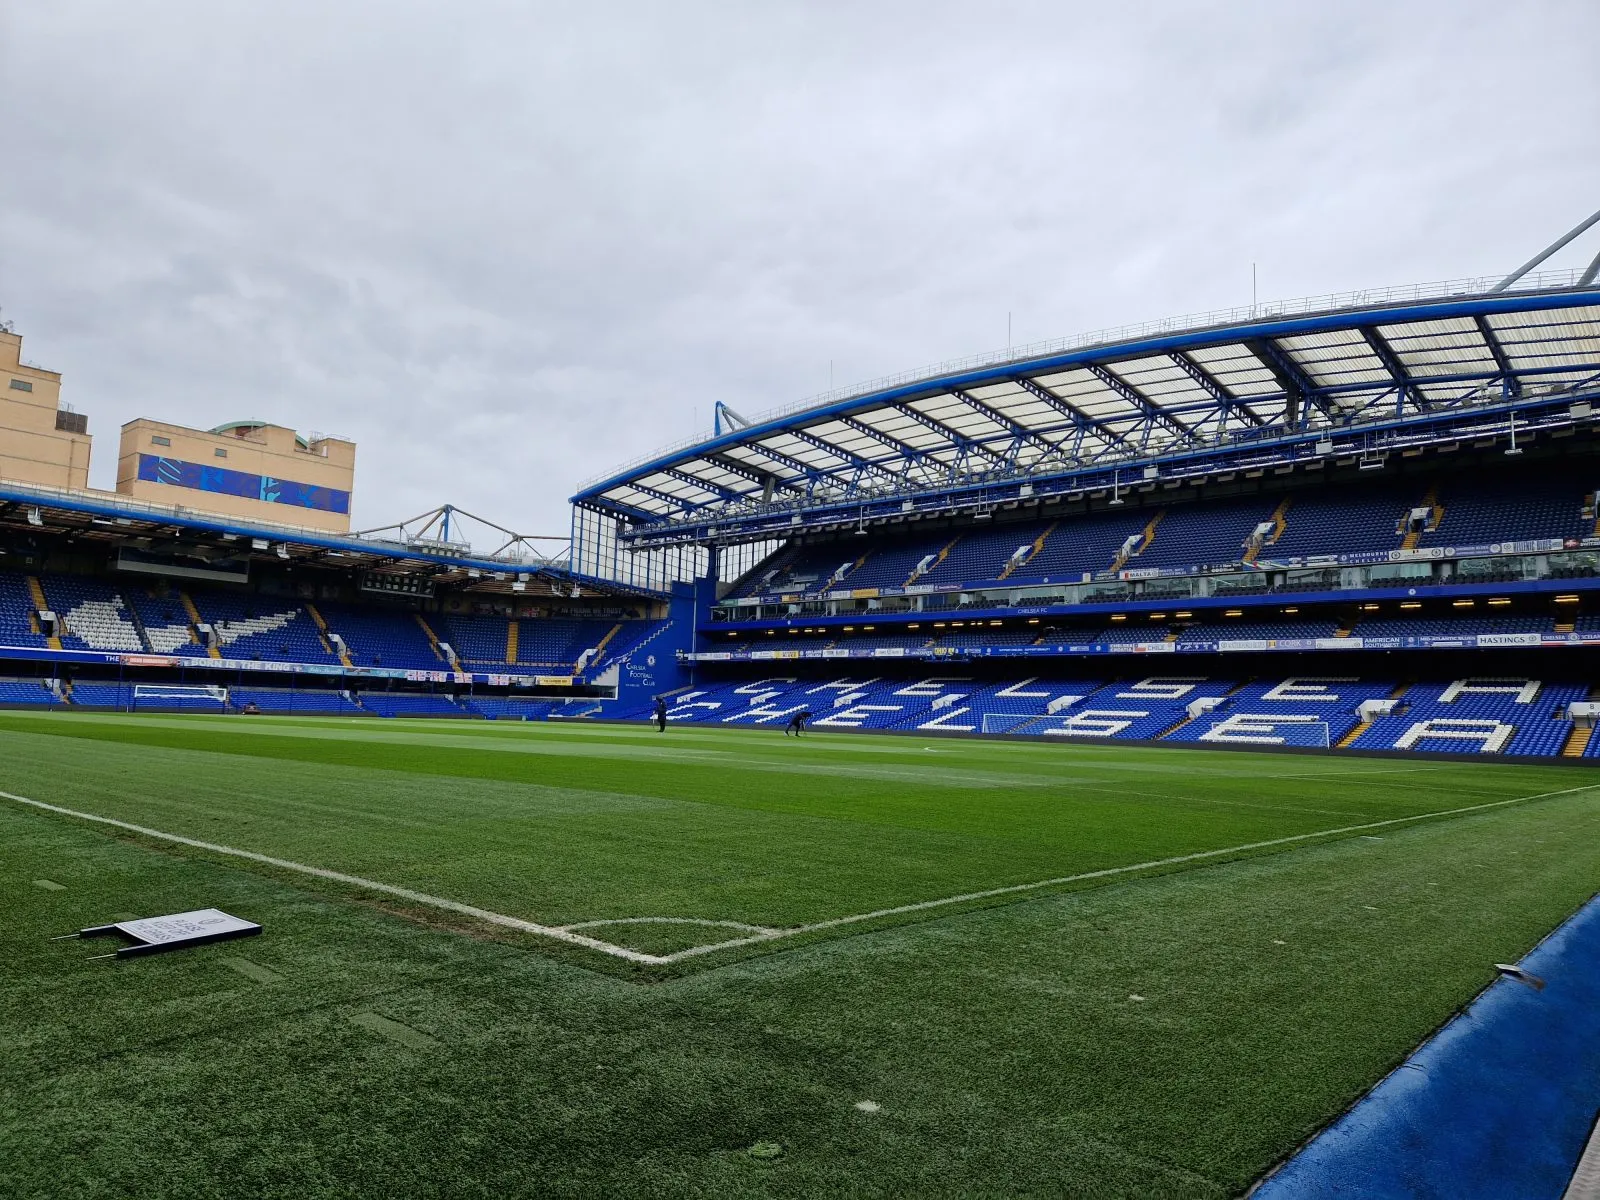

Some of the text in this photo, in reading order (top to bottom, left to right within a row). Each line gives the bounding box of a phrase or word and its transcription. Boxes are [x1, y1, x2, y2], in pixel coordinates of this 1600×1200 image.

[1480, 636, 1526, 644] HASTINGS
[191, 659, 222, 668] BORN
[240, 661, 262, 670] THE
[264, 662, 290, 671] KING
[625, 662, 646, 671] CHELSEA
[629, 670, 653, 678] FOOTBALL
[642, 678, 656, 687] CLUB
